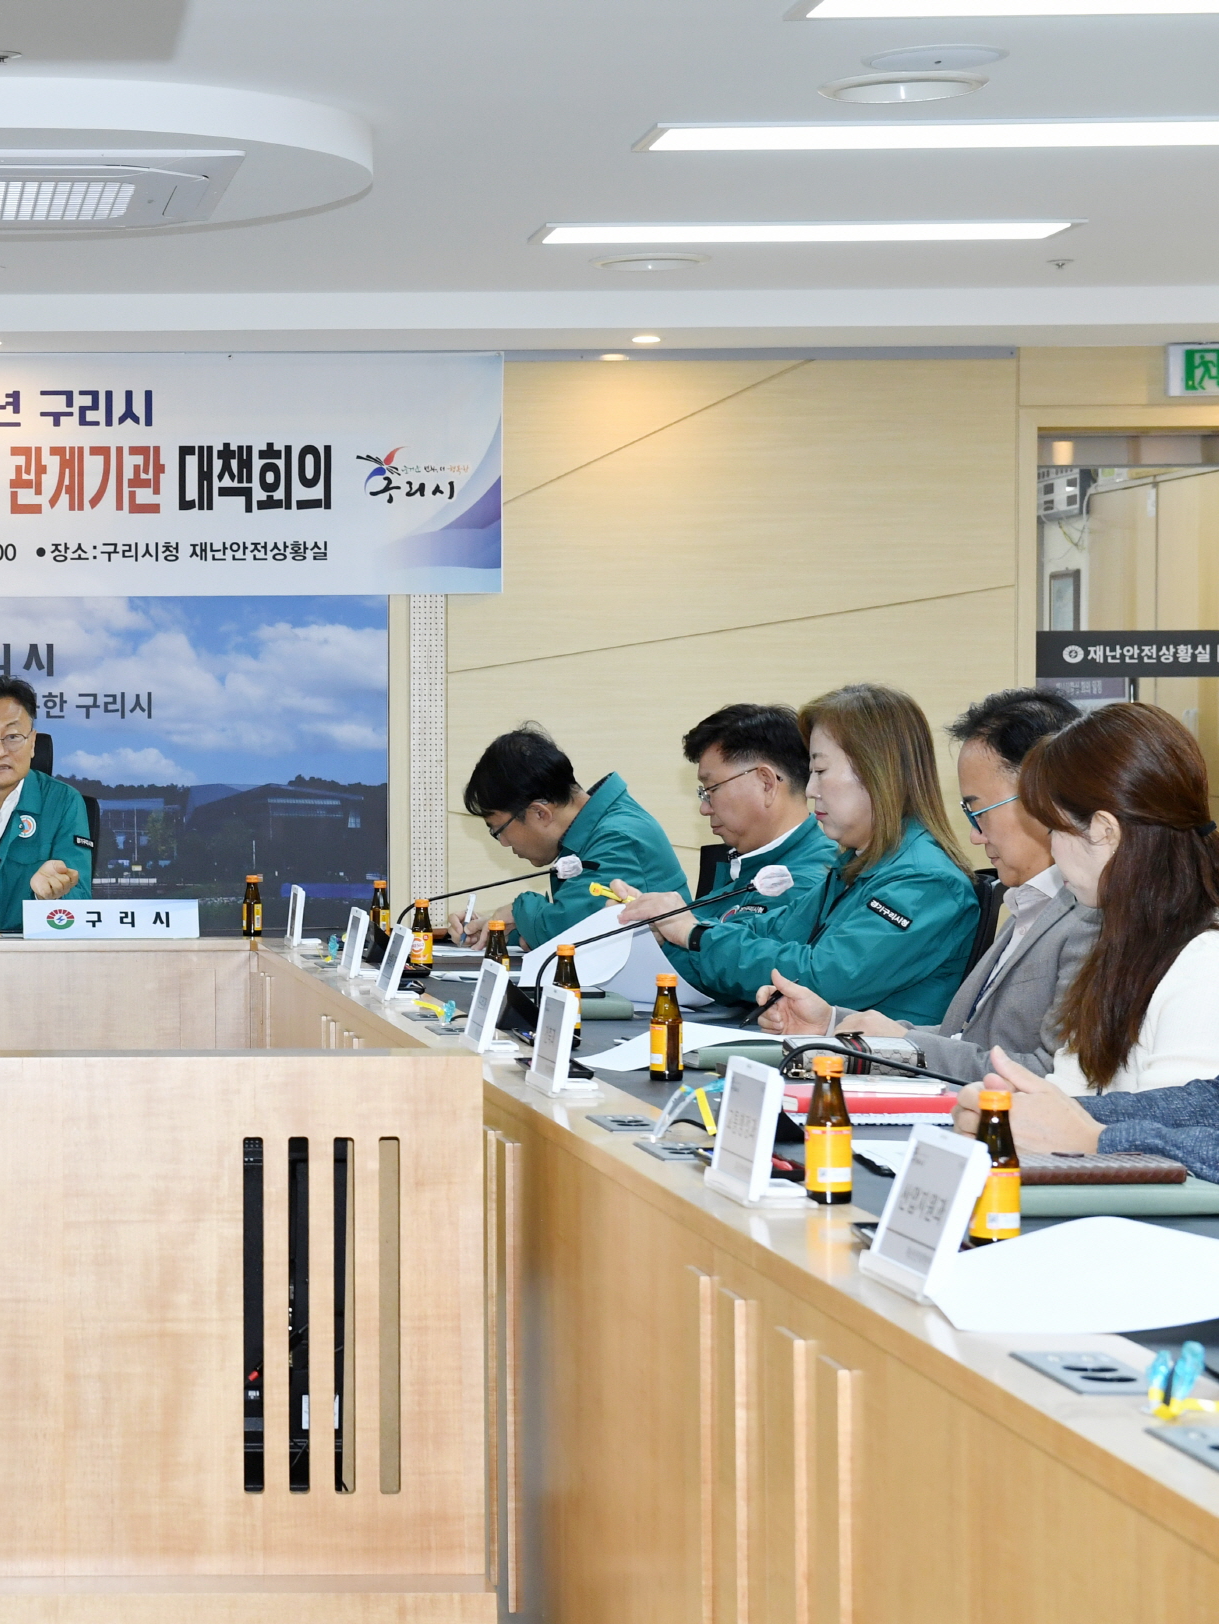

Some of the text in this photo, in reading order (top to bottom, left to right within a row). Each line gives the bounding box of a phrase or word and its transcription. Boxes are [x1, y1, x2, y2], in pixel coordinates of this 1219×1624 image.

[39, 389, 153, 427] 구리시
[9, 444, 166, 515] 관계기관
[178, 441, 332, 514] 대책회의
[369, 476, 455, 504] 구리시
[50, 541, 329, 563] 장소:구리시청 재난안전상황실
[1087, 644, 1211, 664] 재난안전상황실
[74, 691, 153, 720] 구리시
